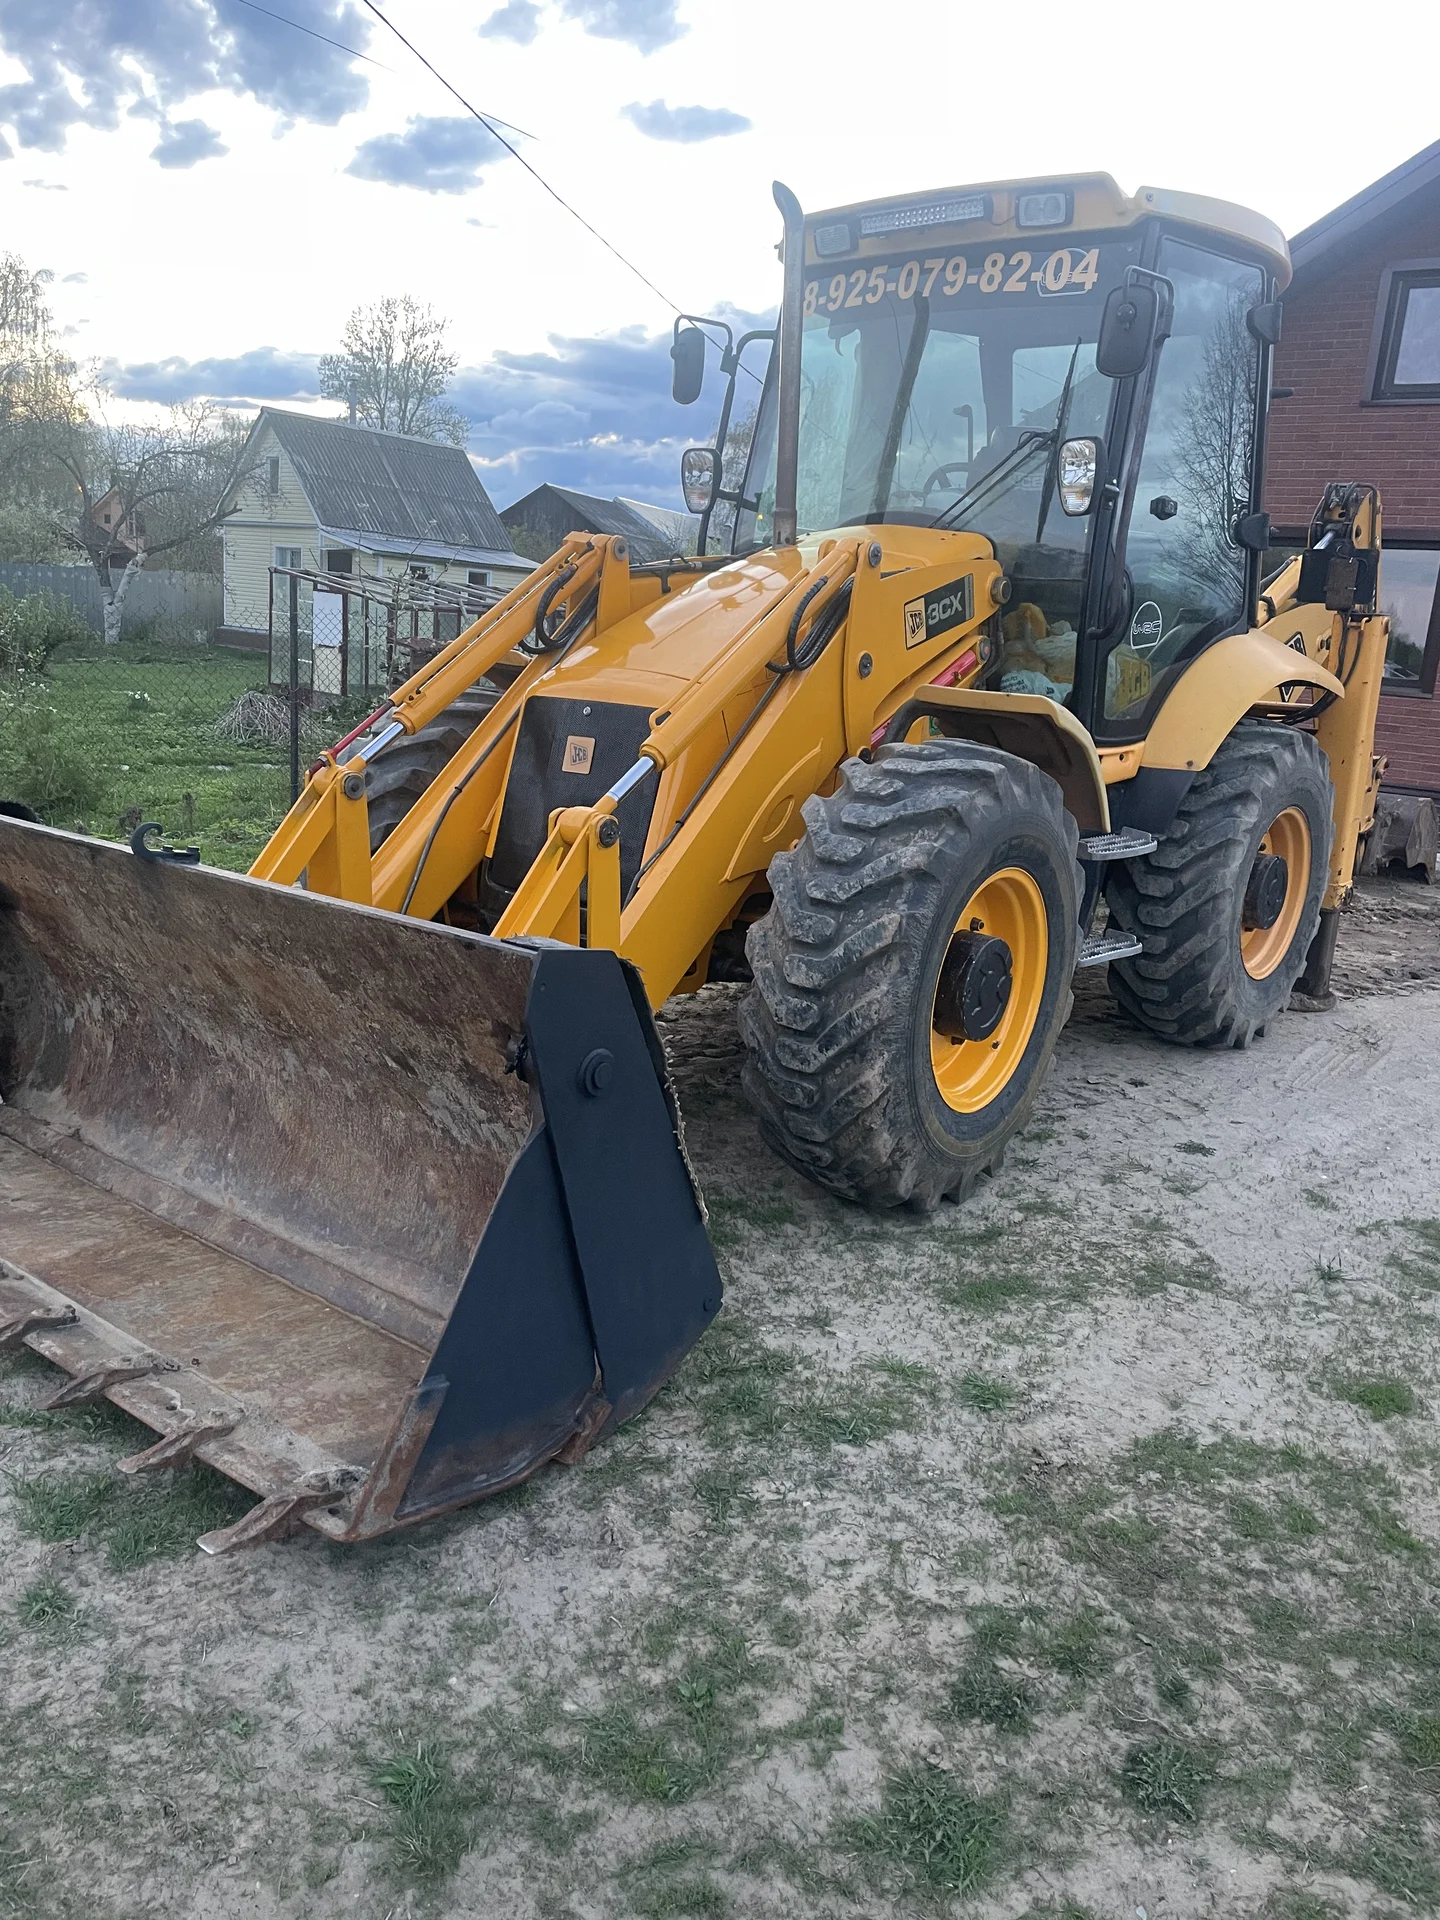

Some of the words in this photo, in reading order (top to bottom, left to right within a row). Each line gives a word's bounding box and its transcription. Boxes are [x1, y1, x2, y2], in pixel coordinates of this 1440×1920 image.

[908, 612, 925, 636] JCB
[926, 591, 963, 626] 3CX
[572, 745, 588, 763] JCB
